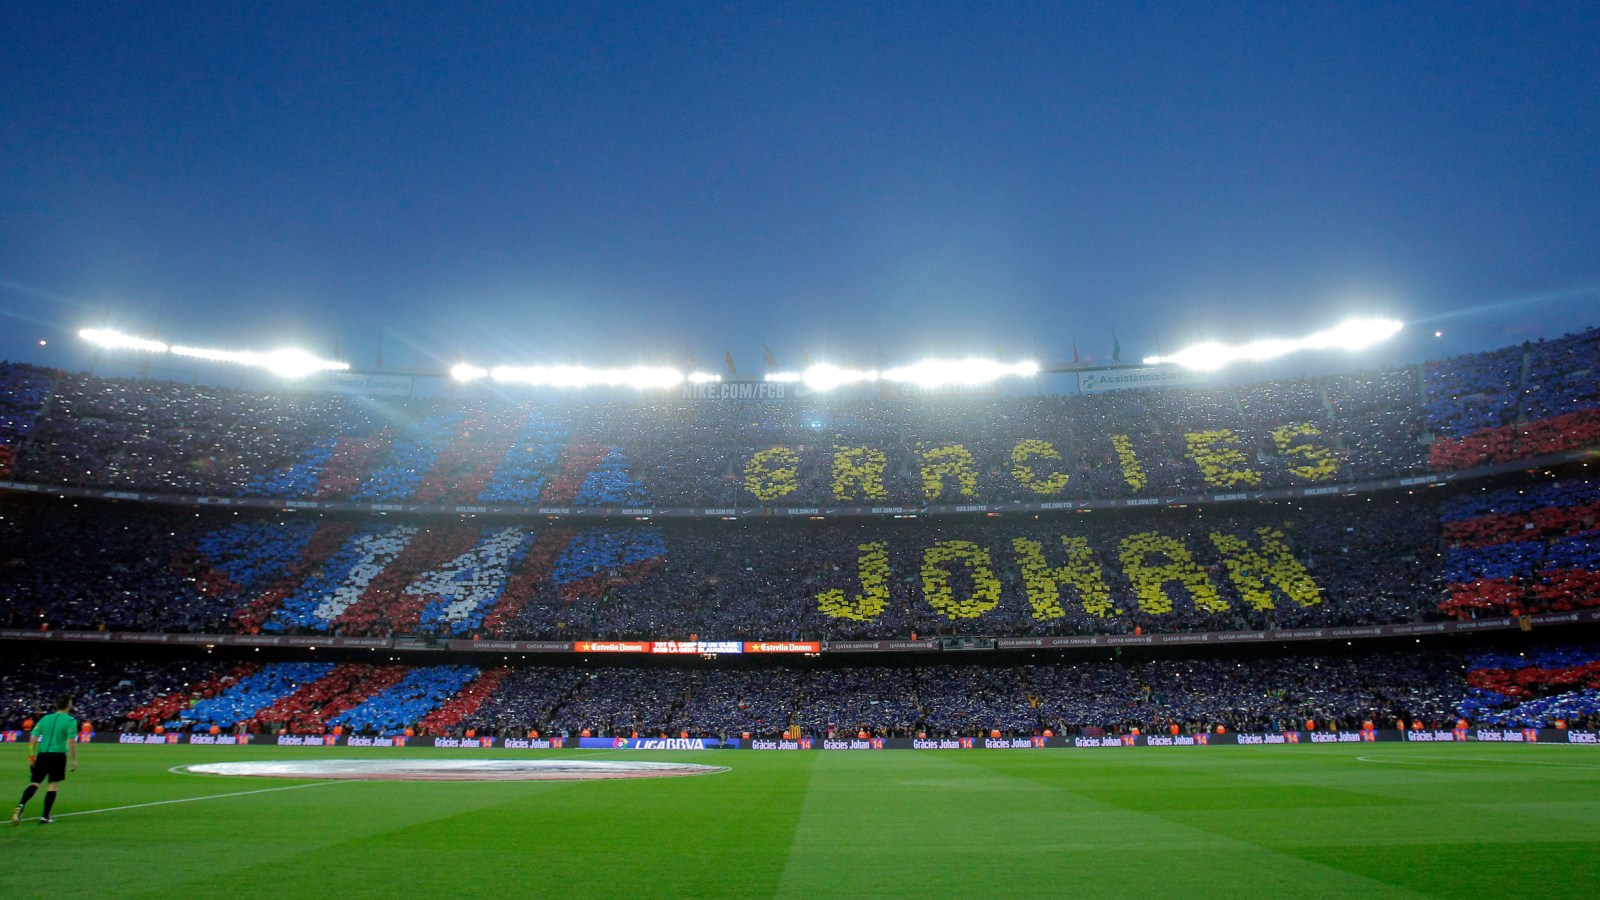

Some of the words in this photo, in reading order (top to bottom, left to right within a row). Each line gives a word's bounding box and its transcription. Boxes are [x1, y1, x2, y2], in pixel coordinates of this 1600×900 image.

[1100, 374, 1160, 384] Assistència
[682, 383, 784, 399] NIKE.COM/FCB
[817, 526, 1322, 621] JOHAN
[591, 643, 618, 651] Estrella
[619, 642, 642, 652] Damm
[760, 643, 788, 651] Estrella
[789, 642, 812, 652] Damm
[120, 733, 145, 744] Gràcies
[146, 733, 166, 744] Johan
[168, 734, 179, 745] 14
[190, 734, 215, 744] Gràcies
[215, 734, 236, 744] Johan
[238, 734, 249, 745] 14
[278, 735, 303, 746] Gràcies
[303, 735, 323, 746] Johan
[325, 735, 336, 746] 14
[347, 736, 372, 747] Gràcies
[372, 736, 393, 747] Johan
[394, 736, 405, 747] 14
[1075, 737, 1100, 748] Gràcies
[1101, 736, 1122, 747] Johan
[1125, 735, 1135, 746] 14
[1147, 735, 1173, 746] Gràcies
[1173, 735, 1194, 746] Johan
[1197, 735, 1208, 746] 14
[1237, 733, 1263, 745] Gràcies
[1263, 733, 1285, 744] Johan
[1288, 732, 1299, 744] 14
[1310, 732, 1337, 743] Gràcies
[1338, 732, 1361, 743] Johan
[1364, 731, 1375, 743] 14
[1408, 730, 1433, 742] Gràcies
[1433, 731, 1454, 742] Johan
[1456, 730, 1467, 742] 14
[1477, 730, 1502, 741] Gràcies
[1502, 730, 1524, 742] Johan
[1525, 730, 1537, 742] 14
[1568, 730, 1597, 743] Gràcies
[434, 737, 459, 748] Gràcies
[459, 738, 480, 748] Johan
[482, 737, 493, 748] 14
[504, 738, 529, 749] Gràcies
[529, 738, 550, 749] Johan
[552, 738, 563, 748] 14
[752, 740, 777, 750] Gràcies
[777, 740, 798, 750] Johan
[801, 739, 811, 750] 14
[823, 739, 849, 750] Gràcies
[849, 739, 870, 750] Johan
[872, 739, 883, 750] 14
[913, 739, 938, 749] Gràcies
[939, 739, 960, 749] Johan
[962, 738, 973, 749] 14
[985, 738, 1010, 749] Gràcies
[1011, 738, 1032, 749] Johan
[1034, 738, 1045, 749] 14
